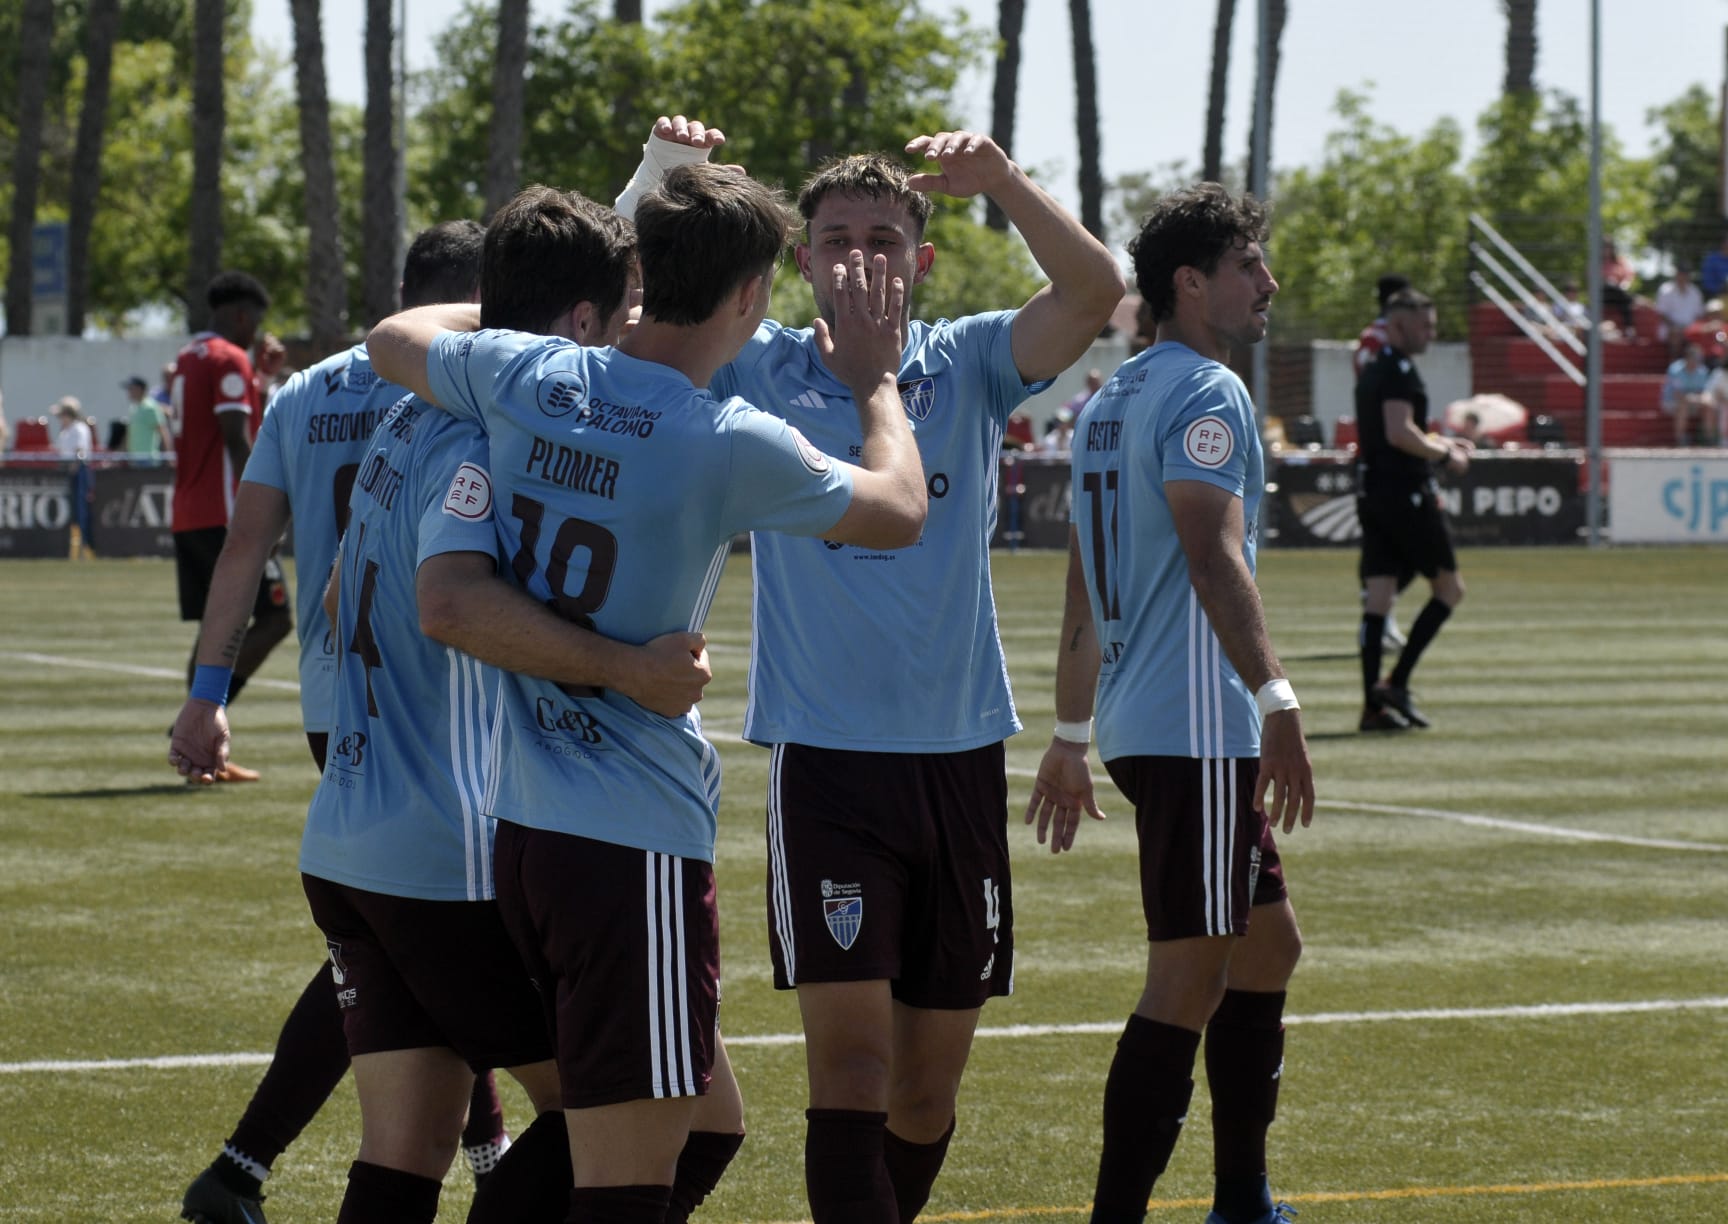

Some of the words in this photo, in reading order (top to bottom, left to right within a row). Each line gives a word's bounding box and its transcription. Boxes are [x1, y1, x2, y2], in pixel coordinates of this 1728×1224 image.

[575, 407, 655, 439] PALOMO
[588, 397, 663, 421] OCTAVIANO
[526, 436, 620, 500] PLOMER
[1474, 487, 1562, 516] PEPO
